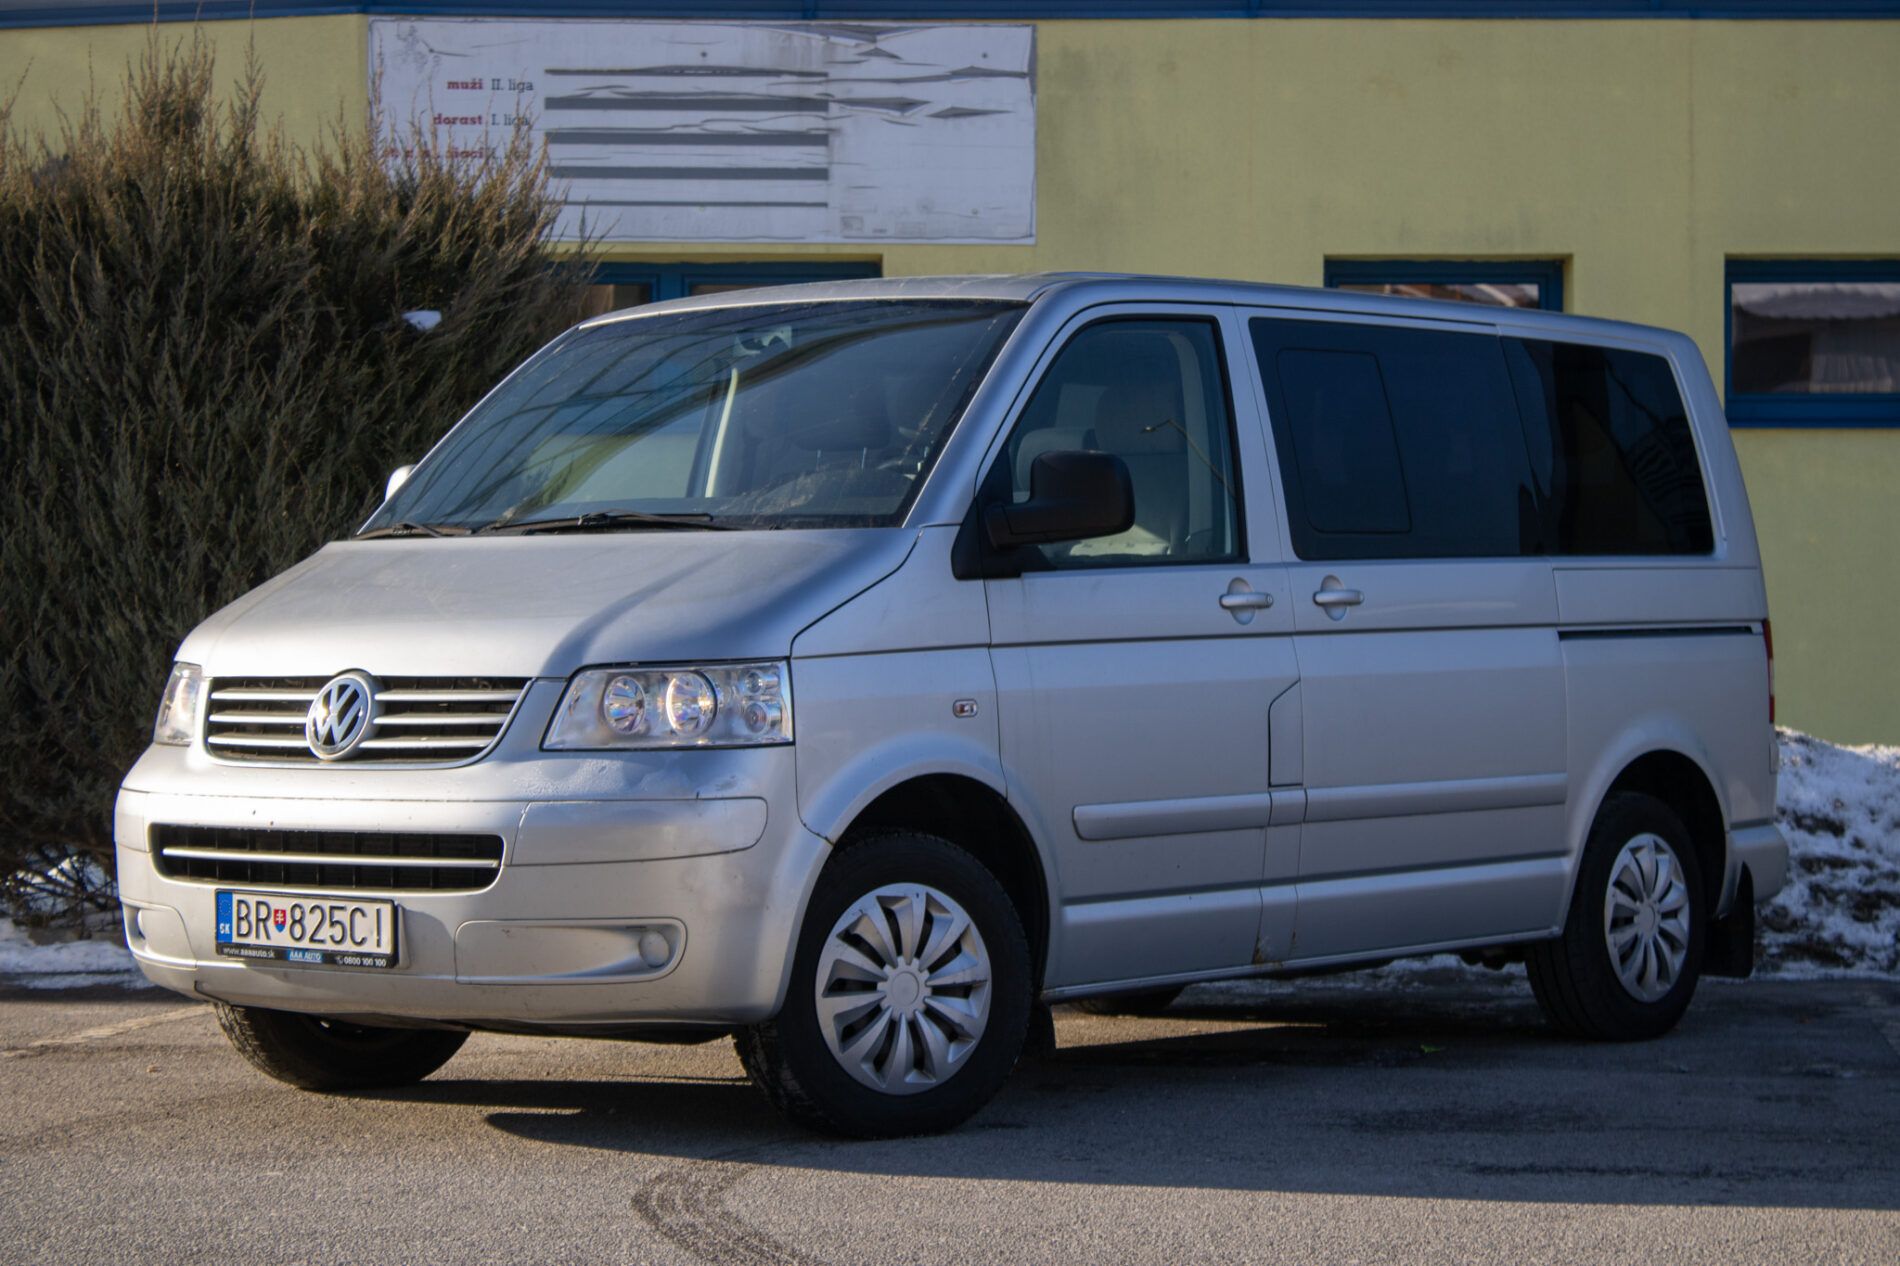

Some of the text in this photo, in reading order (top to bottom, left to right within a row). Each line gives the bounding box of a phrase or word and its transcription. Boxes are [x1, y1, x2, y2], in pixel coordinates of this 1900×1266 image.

[508, 78, 534, 94] liga
[432, 113, 483, 126] dorast
[219, 922, 231, 935] SK
[236, 899, 382, 948] BR 825CI
[289, 950, 321, 961] AAA AUTO
[343, 955, 361, 965] 0800
